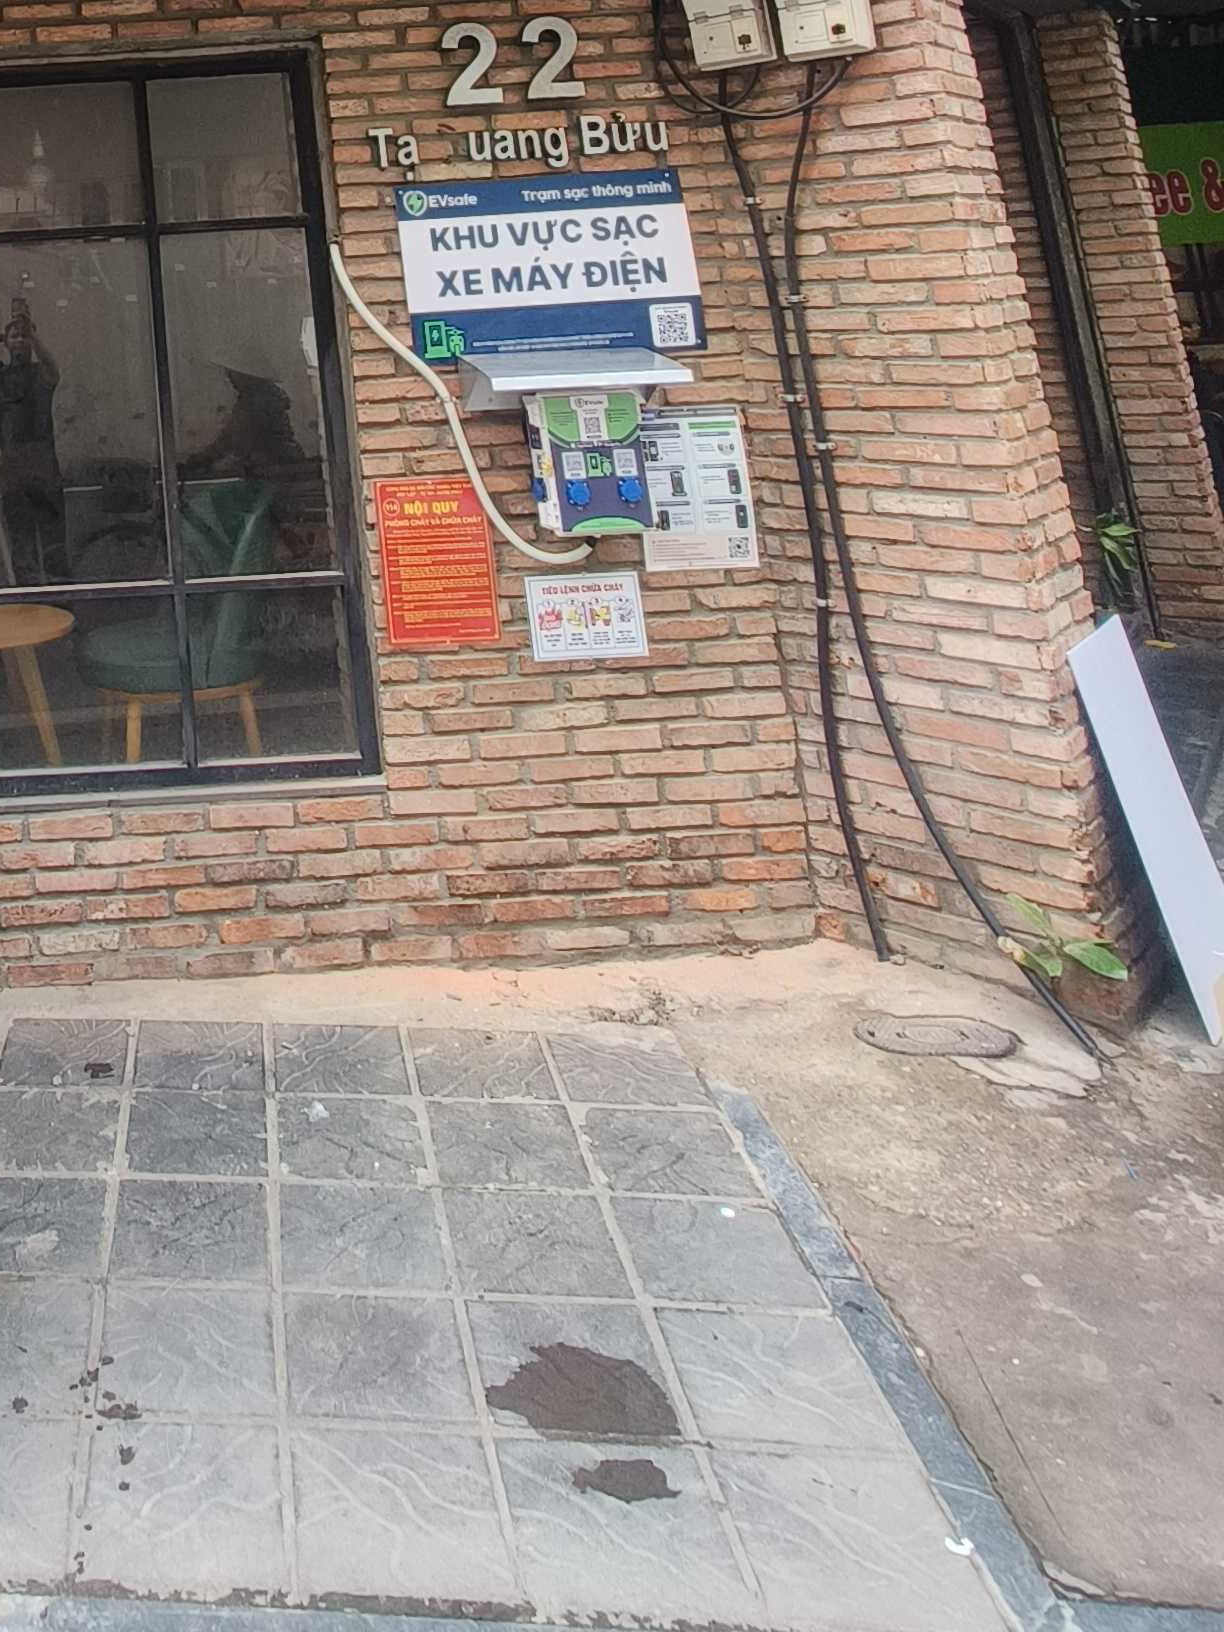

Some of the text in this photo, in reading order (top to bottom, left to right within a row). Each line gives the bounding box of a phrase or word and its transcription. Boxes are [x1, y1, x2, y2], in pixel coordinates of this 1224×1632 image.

[441, 16, 587, 108] 22
[368, 127, 421, 181] Tạ
[579, 111, 670, 156] Bửu
[428, 193, 478, 208] EVsafe
[521, 180, 673, 204] Trạm sạc thông minh
[430, 213, 660, 252] KHU VỰC SẠC
[436, 250, 669, 298] XE MÁY ĐIỆN
[403, 500, 429, 517] NỘI
[432, 500, 460, 515] QUY
